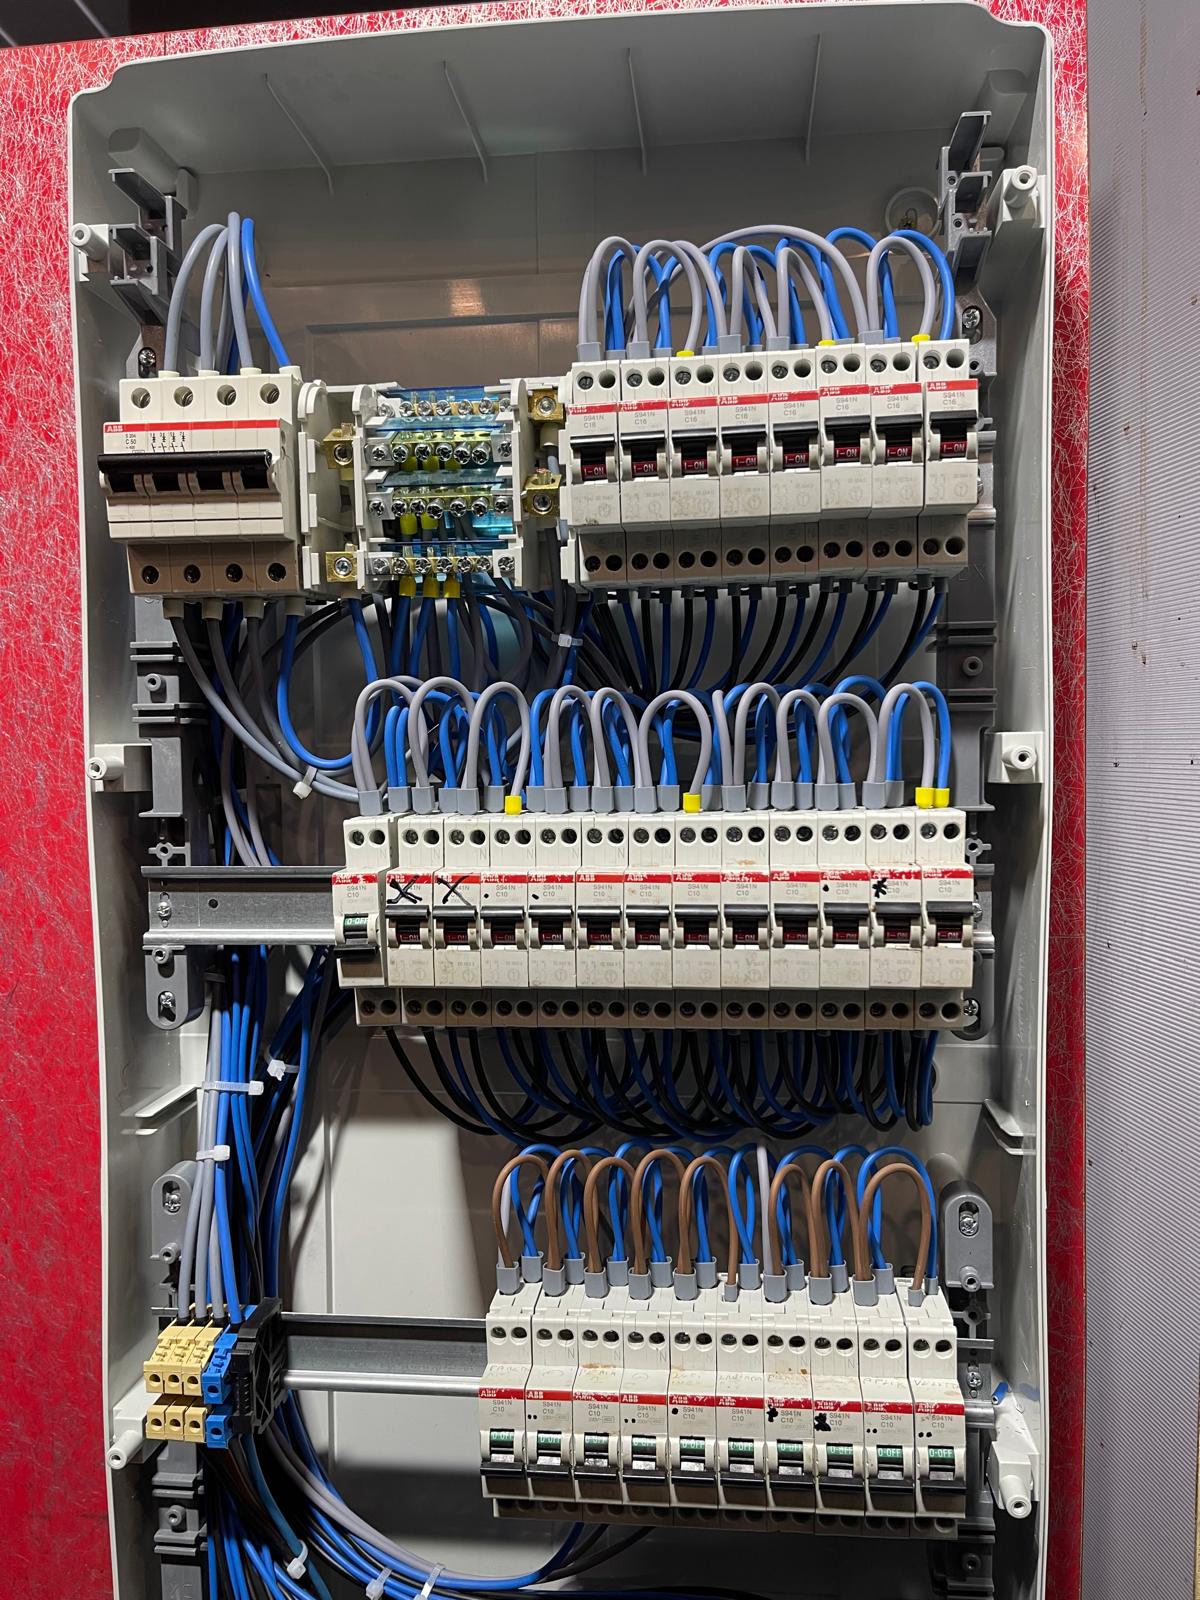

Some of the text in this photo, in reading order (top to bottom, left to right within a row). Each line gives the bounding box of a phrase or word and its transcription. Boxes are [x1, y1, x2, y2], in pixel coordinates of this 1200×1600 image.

[873, 385, 891, 394] ABB
[929, 382, 947, 390] ABB
[721, 396, 738, 404] ABB
[579, 874, 595, 882] ABB
[527, 1391, 543, 1399] ABB
